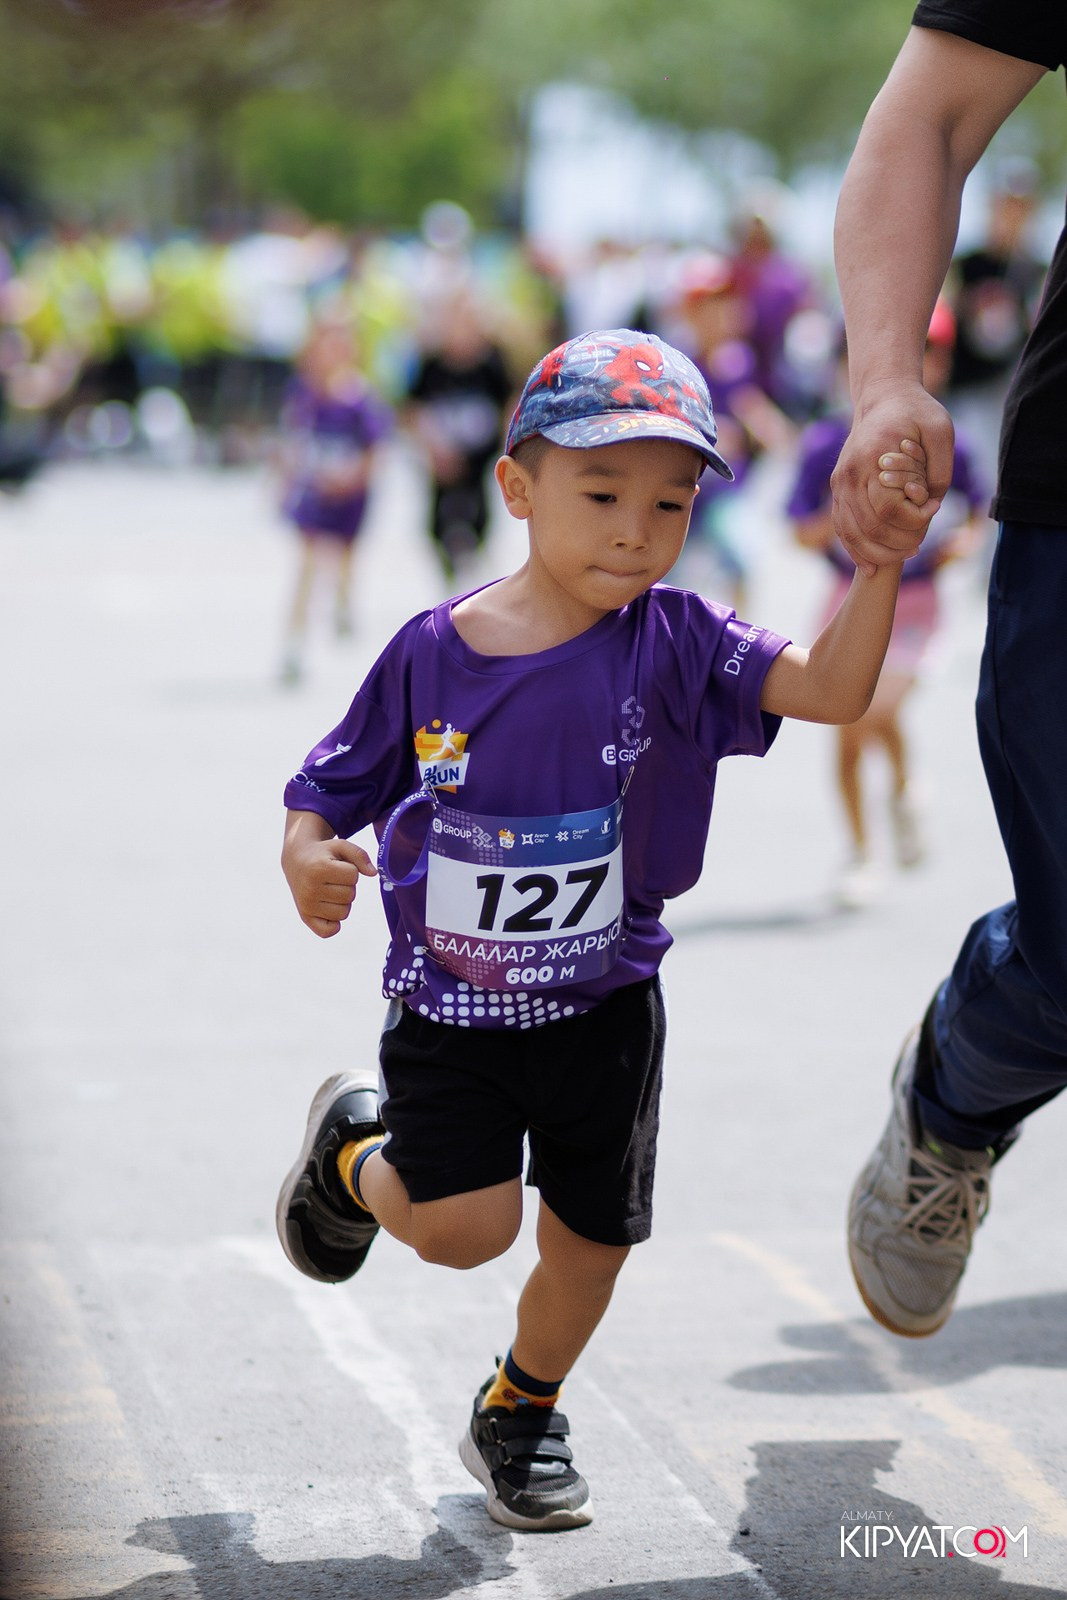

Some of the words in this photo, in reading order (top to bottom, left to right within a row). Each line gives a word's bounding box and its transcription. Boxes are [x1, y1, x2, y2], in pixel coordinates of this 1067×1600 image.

[443, 824, 472, 839] GROUP
[476, 861, 610, 933] 127
[434, 933, 537, 963] БАЛАЛАР
[541, 922, 621, 962] ЖАРЫС
[505, 965, 554, 985] 600
